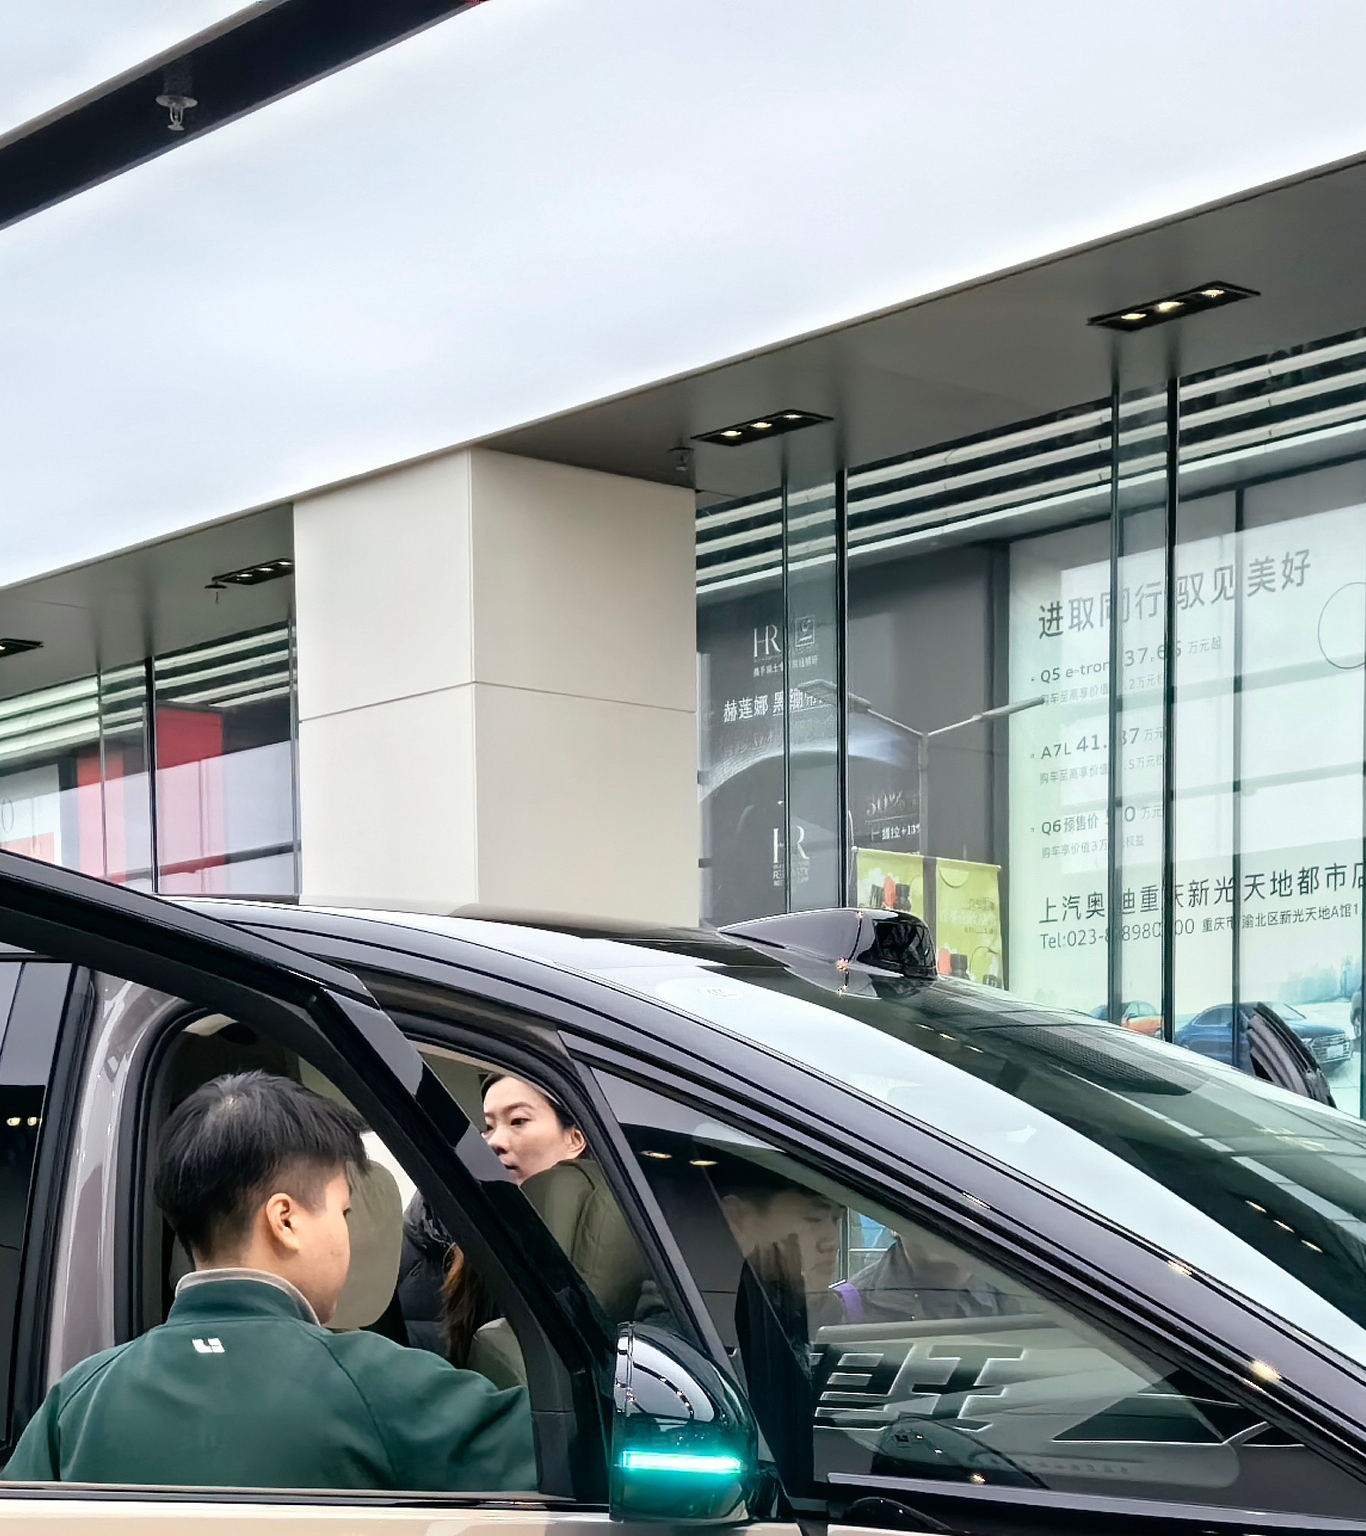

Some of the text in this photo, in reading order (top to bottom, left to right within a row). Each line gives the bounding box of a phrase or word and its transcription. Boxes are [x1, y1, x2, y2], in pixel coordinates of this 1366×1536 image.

[753, 624, 782, 658] HR
[1040, 667, 1061, 683] Q5
[1040, 742, 1071, 760] A7L
[1041, 819, 1062, 835] Q6
[1063, 813, 1099, 834] 预售价
